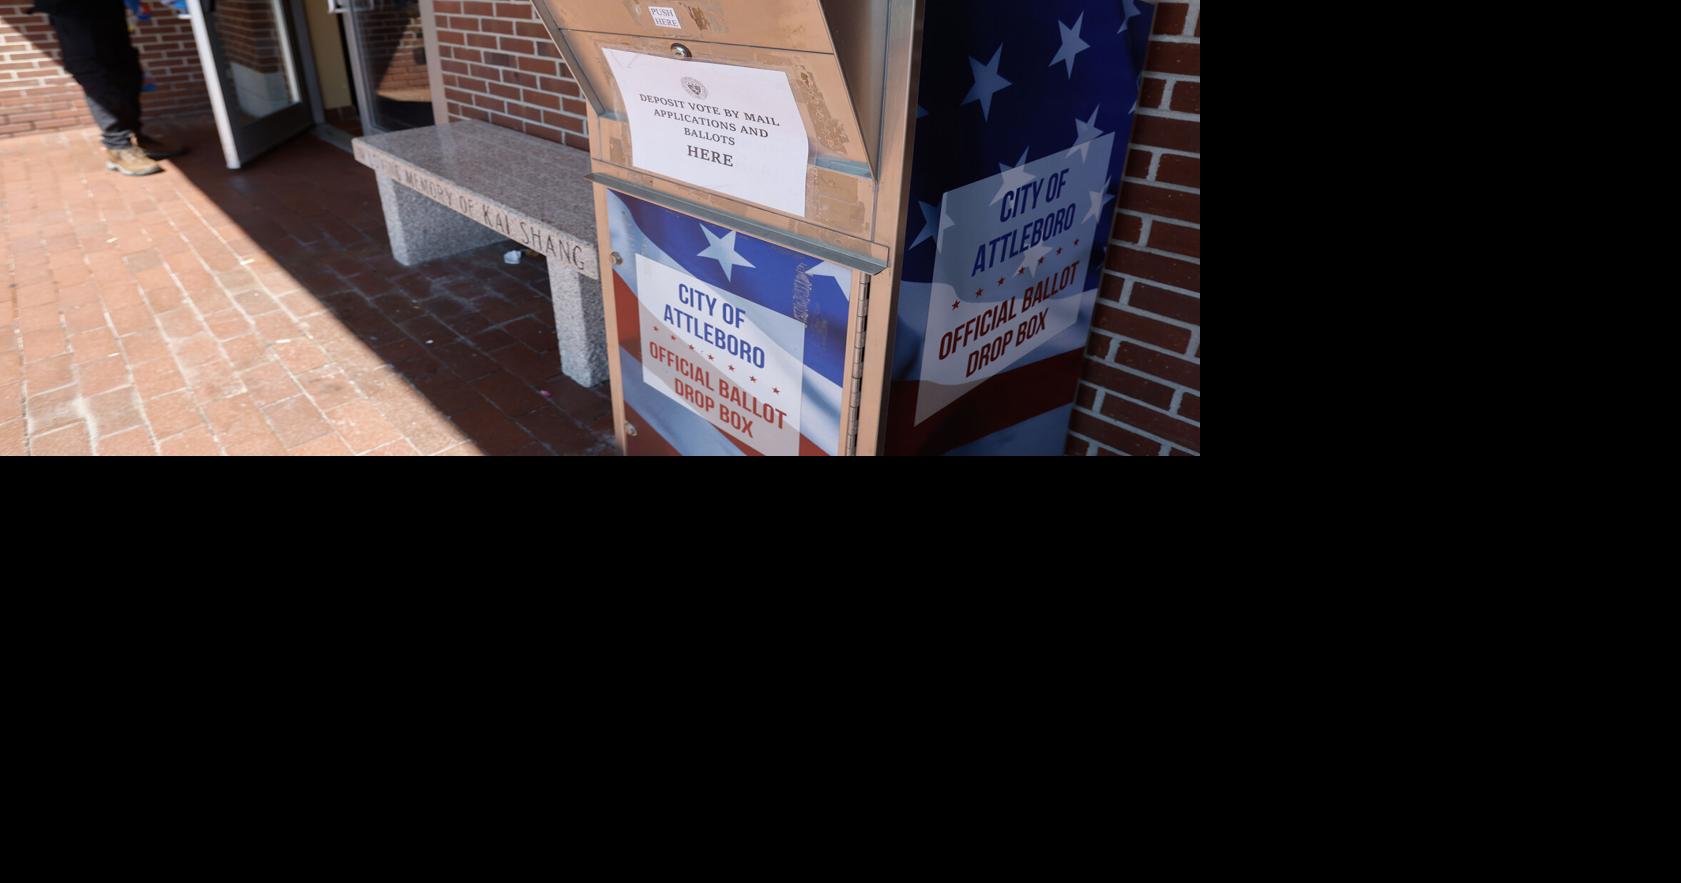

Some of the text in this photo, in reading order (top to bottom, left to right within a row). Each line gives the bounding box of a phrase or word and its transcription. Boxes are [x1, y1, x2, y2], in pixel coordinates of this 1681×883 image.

[651, 8, 673, 17] PUSH
[655, 18, 678, 27] HERE
[639, 93, 780, 126] DEPOSIT VOTE BY MAIL
[654, 109, 769, 138] APPLICATIONS AND
[684, 127, 736, 146] BALLOTS
[687, 145, 734, 167] HERE
[1000, 168, 1070, 222] CITY OF
[459, 195, 475, 214] OF
[482, 204, 511, 235] KAI
[520, 221, 585, 270] SHANG
[971, 203, 1076, 277] ATTLEBORO
[678, 283, 746, 329] CITY OF
[939, 260, 1080, 361] OFFICIAL BALLOT
[663, 303, 765, 369] ATTLEBORO
[965, 307, 1049, 378] DROP BOX
[649, 341, 787, 430] OFFICIAL BALLOT
[674, 377, 754, 438] DROP BOX
